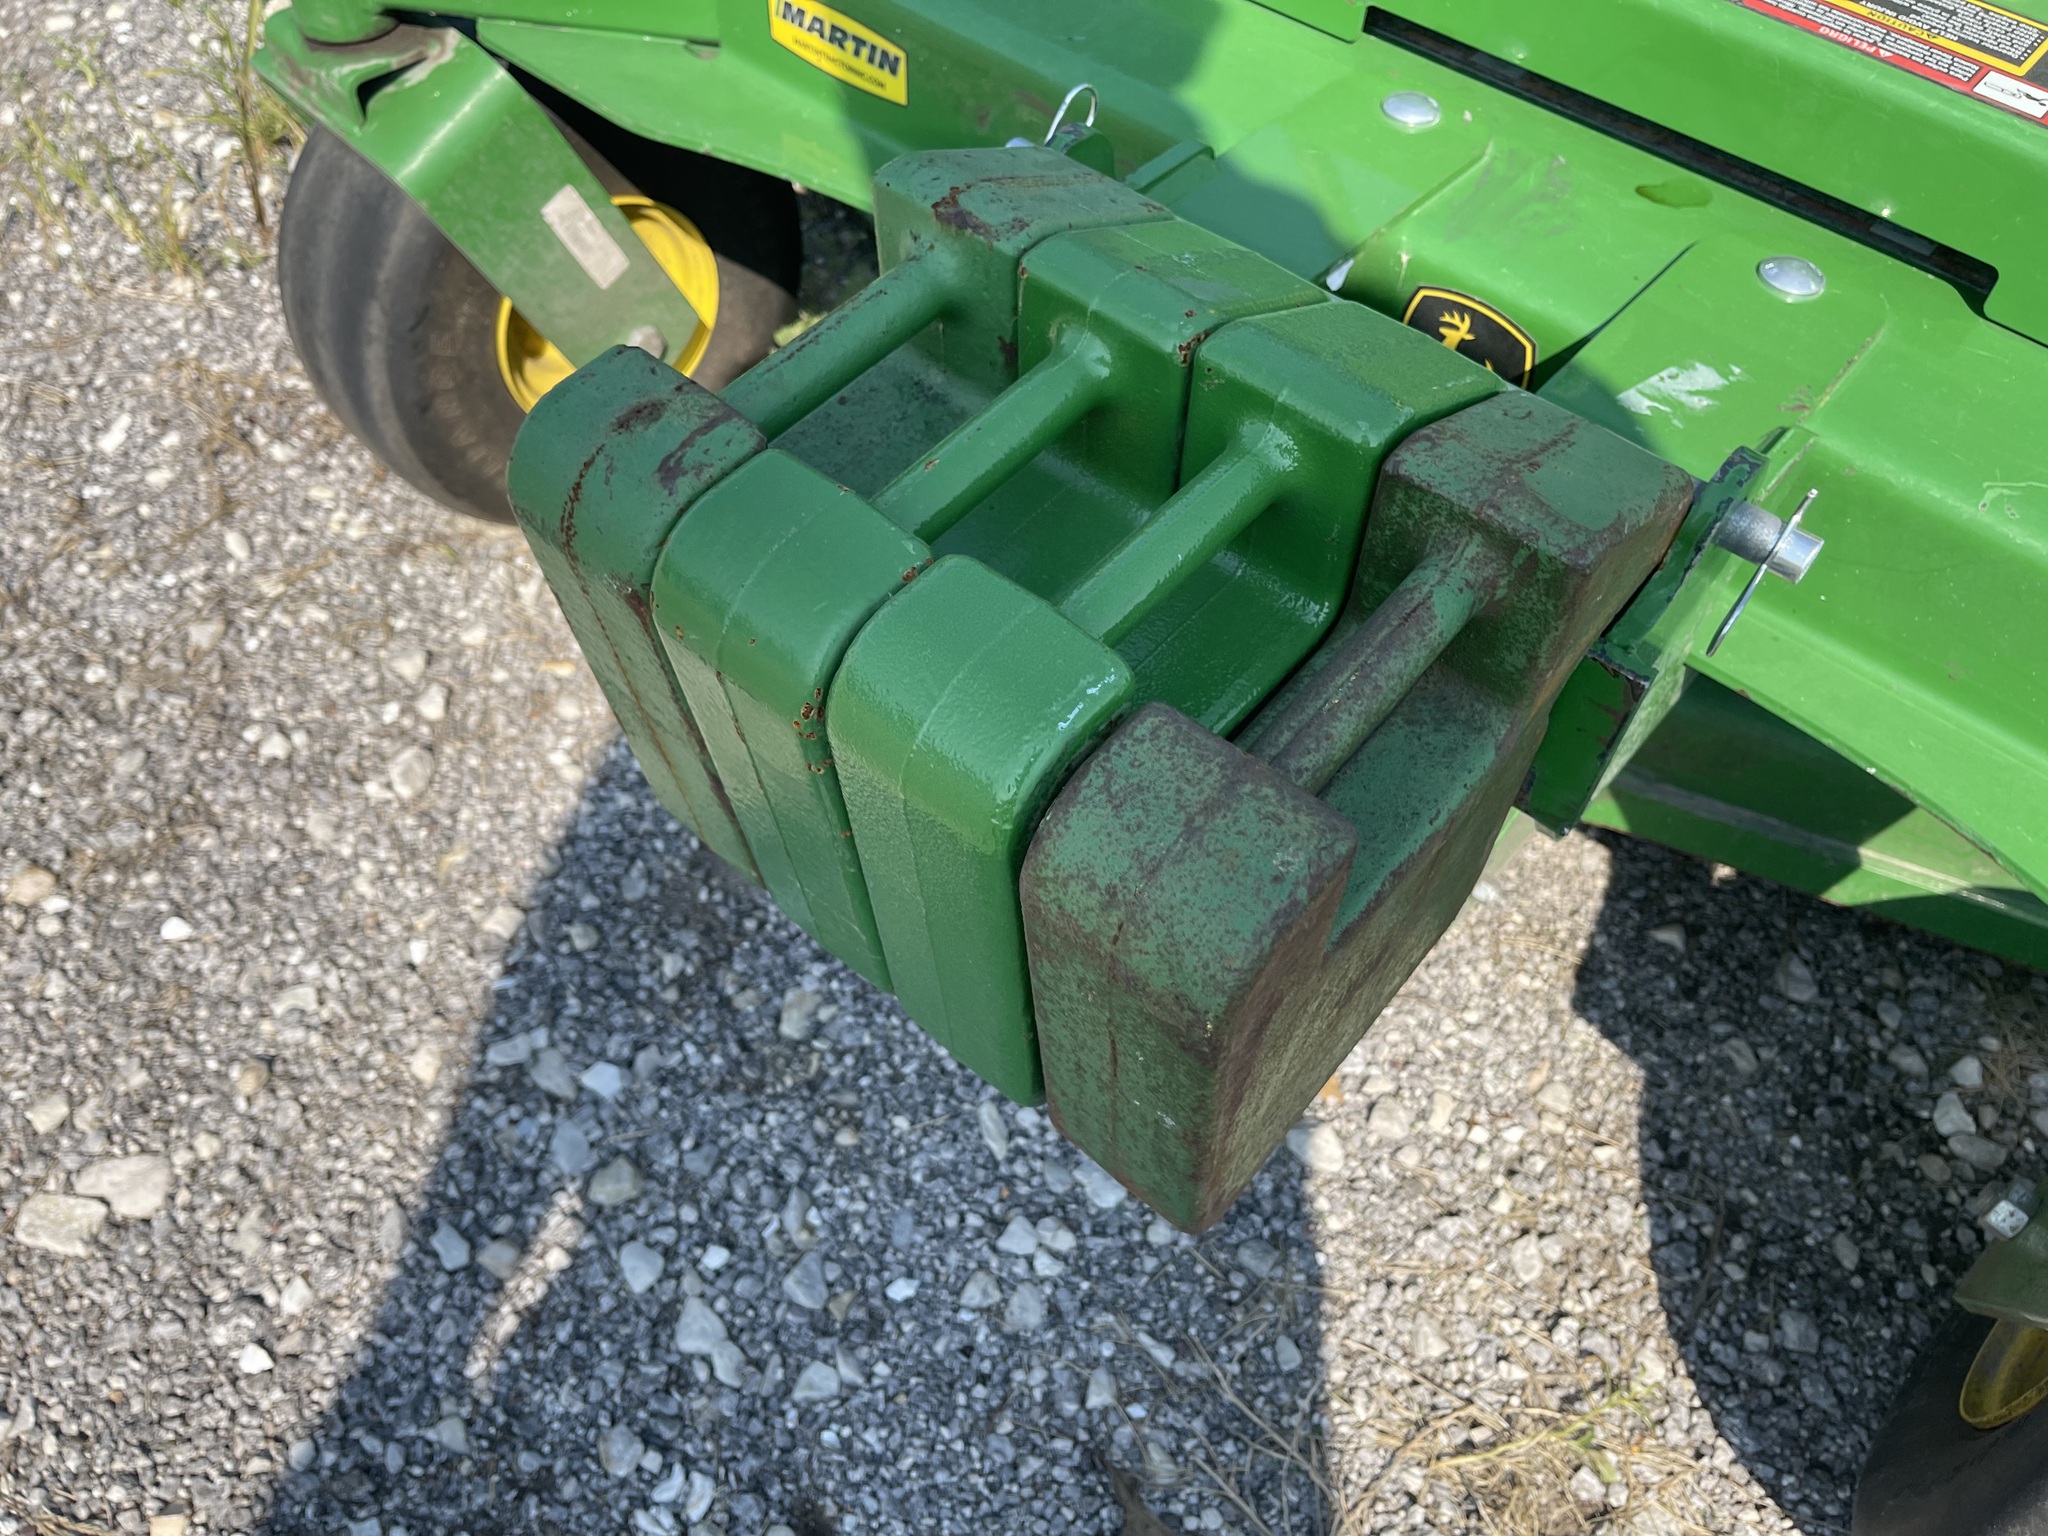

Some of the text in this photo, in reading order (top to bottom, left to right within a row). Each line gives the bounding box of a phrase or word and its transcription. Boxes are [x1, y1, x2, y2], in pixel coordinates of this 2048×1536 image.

[1866, 10, 1924, 36] CAUTION
[782, 1, 900, 76] MARTIN
[1817, 25, 1877, 53] PELIGRO
